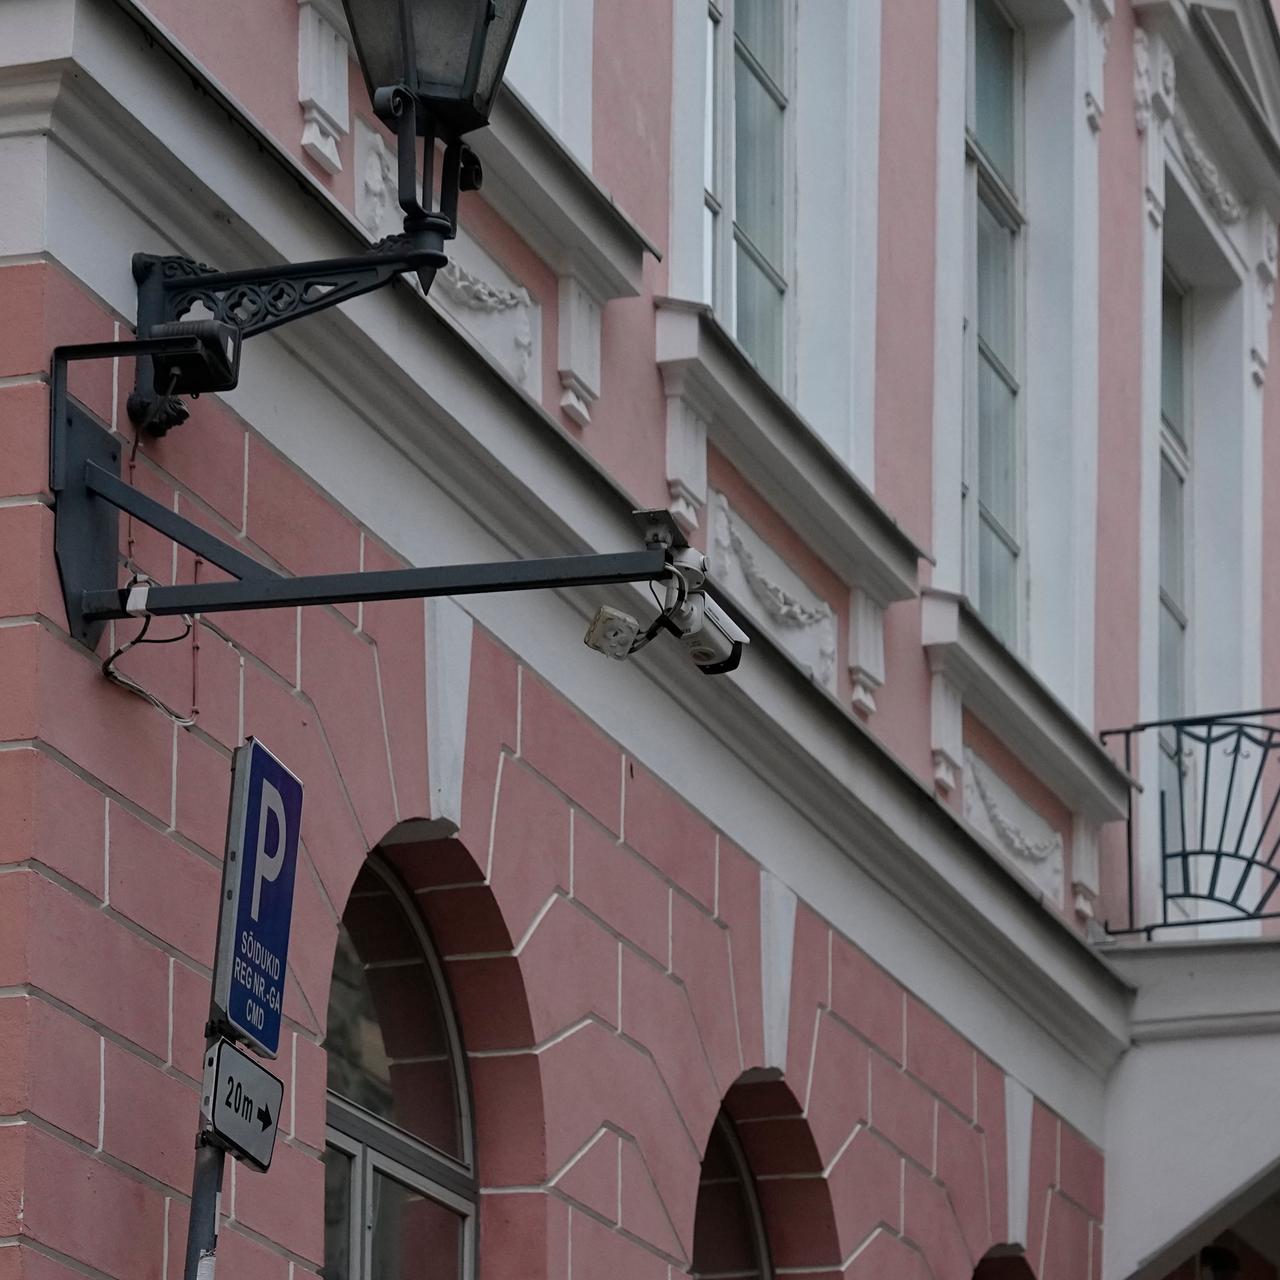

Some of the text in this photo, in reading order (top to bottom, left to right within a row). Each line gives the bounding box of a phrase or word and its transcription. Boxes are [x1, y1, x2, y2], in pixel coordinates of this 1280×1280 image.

[251, 778, 287, 922] P
[241, 930, 280, 981] SÕIDUKID
[234, 957, 281, 1015] REG NR.-GA
[246, 999, 265, 1031] CMD
[225, 1076, 254, 1123] 20m
